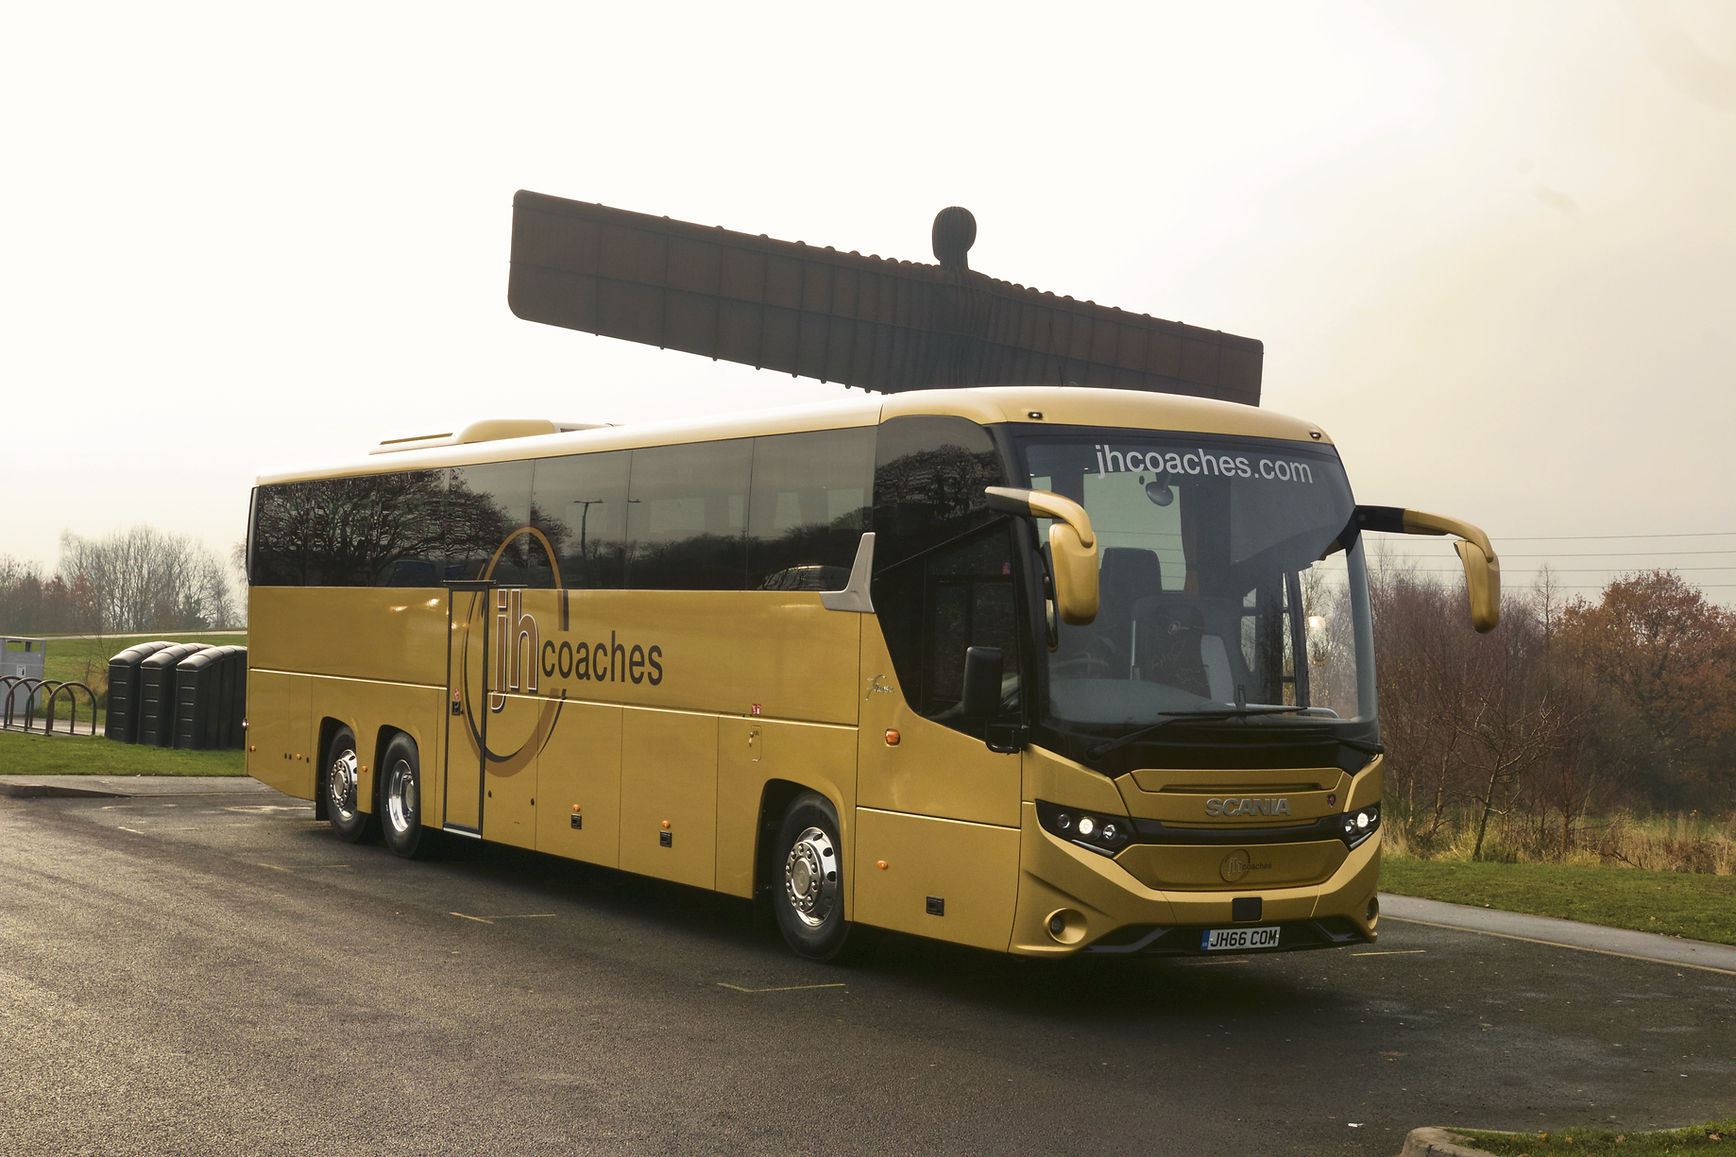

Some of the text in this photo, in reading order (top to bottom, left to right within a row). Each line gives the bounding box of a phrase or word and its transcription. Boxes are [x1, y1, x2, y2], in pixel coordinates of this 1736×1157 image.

[1095, 444, 1313, 484] jhcoaches.com
[542, 630, 663, 686] coaches
[1205, 797, 1292, 817] SCANIA
[1210, 929, 1277, 947] JH66 COM
